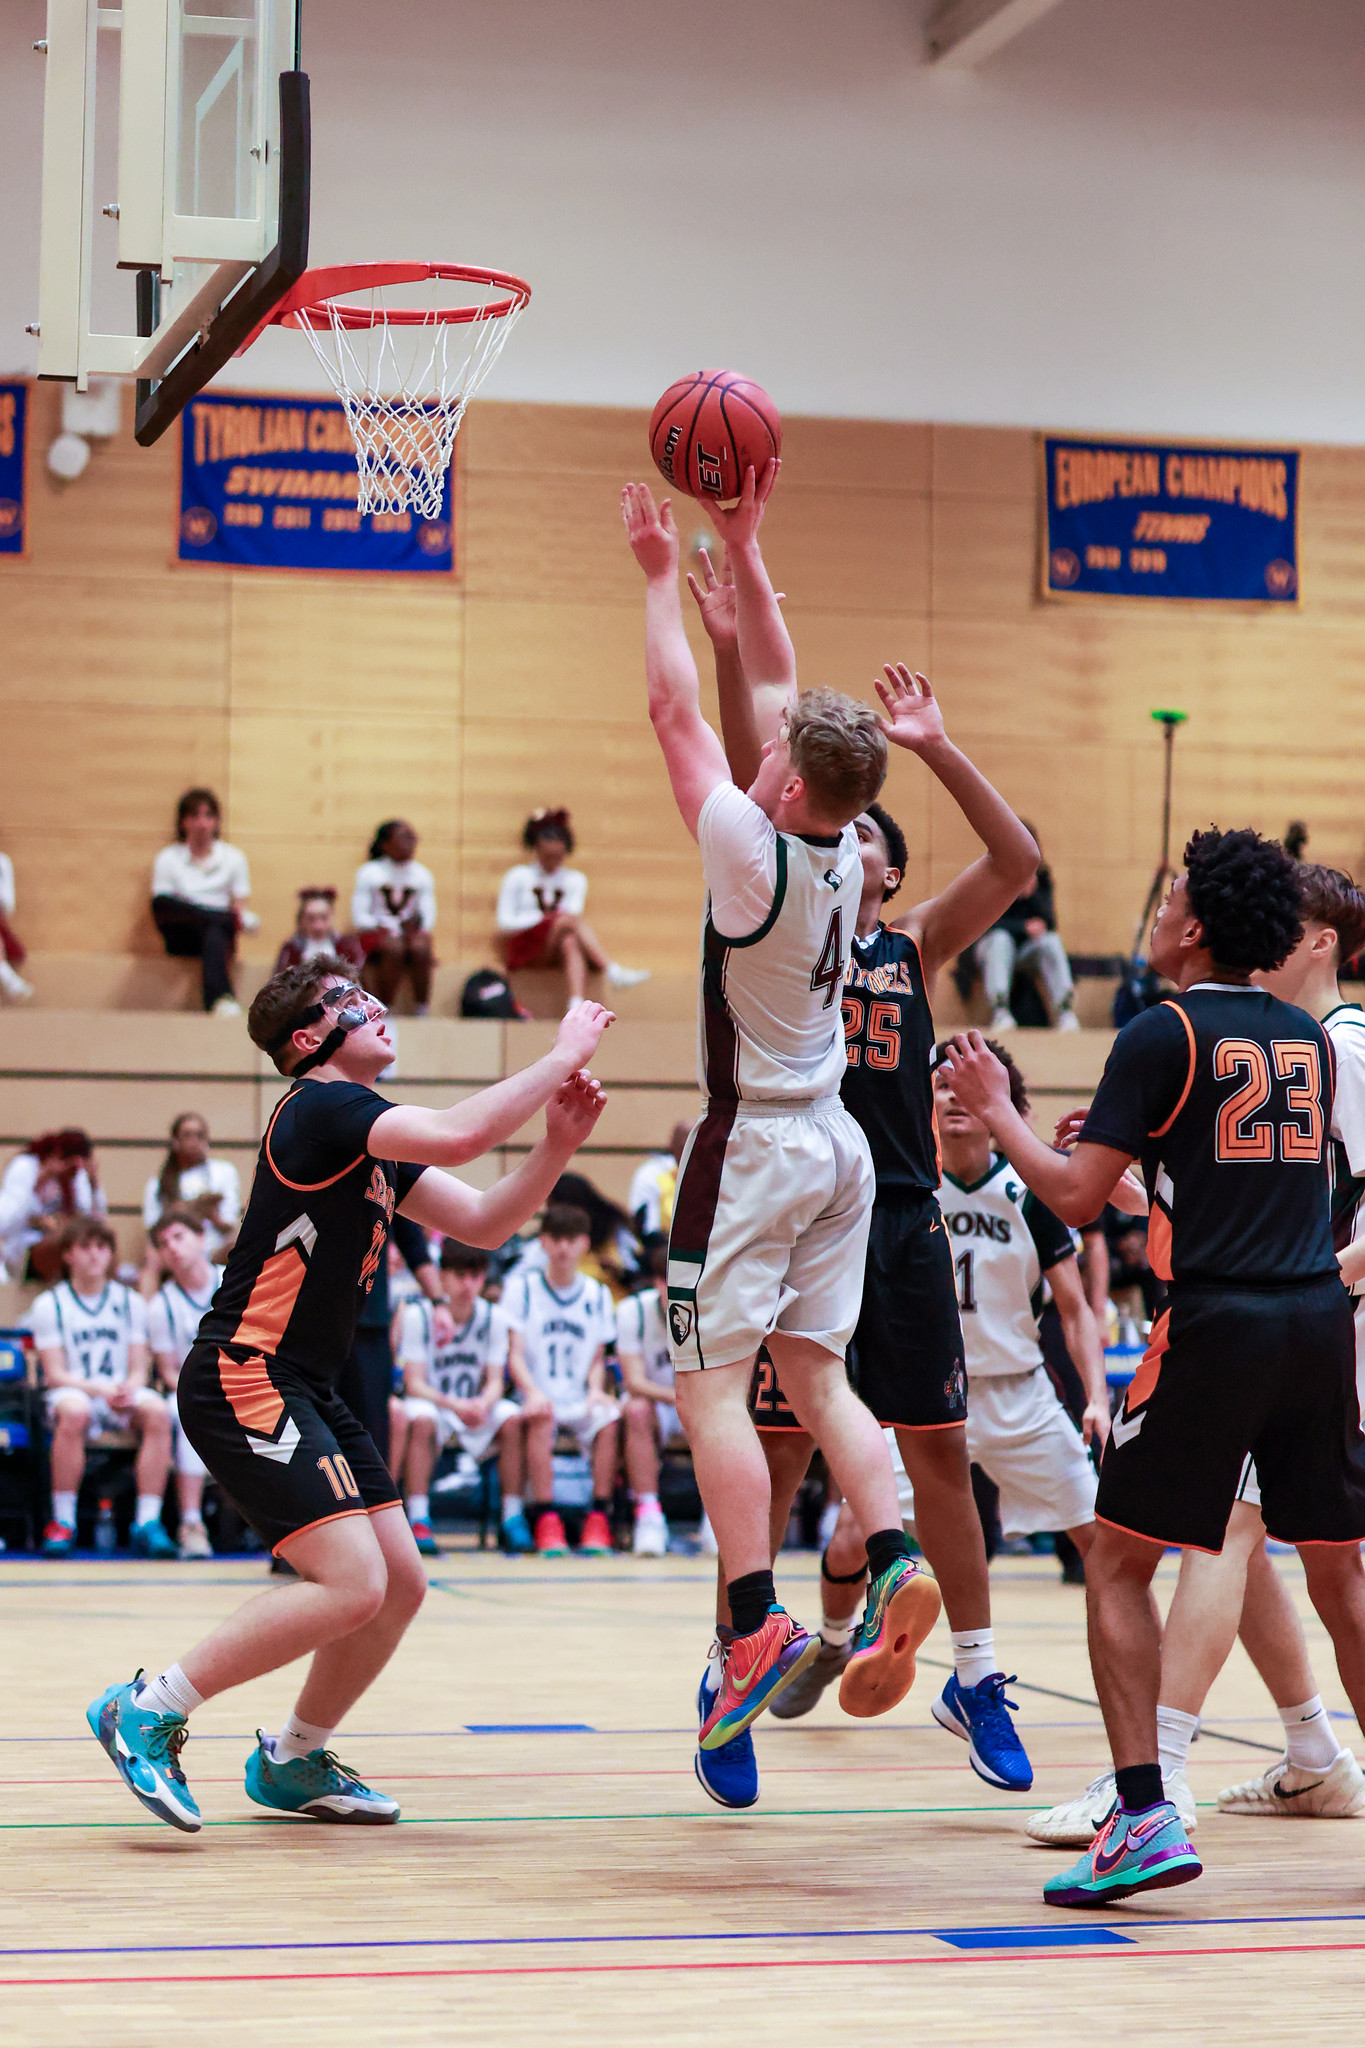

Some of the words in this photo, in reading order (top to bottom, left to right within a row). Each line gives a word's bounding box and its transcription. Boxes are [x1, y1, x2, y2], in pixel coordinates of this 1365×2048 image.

[224, 466, 412, 501] SWIMM
[697, 442, 724, 498] JET
[1055, 447, 1160, 510] EUROPEAN
[1165, 453, 1288, 521] CHAMPIONS
[379, 884, 415, 916] V
[809, 905, 845, 1010] 4
[841, 997, 901, 1071] 25
[1213, 1037, 1324, 1164] 23
[944, 1210, 1012, 1244] ONS
[82, 1350, 113, 1379] 14
[755, 1361, 794, 1412] 2
[316, 1453, 361, 1501] 10
